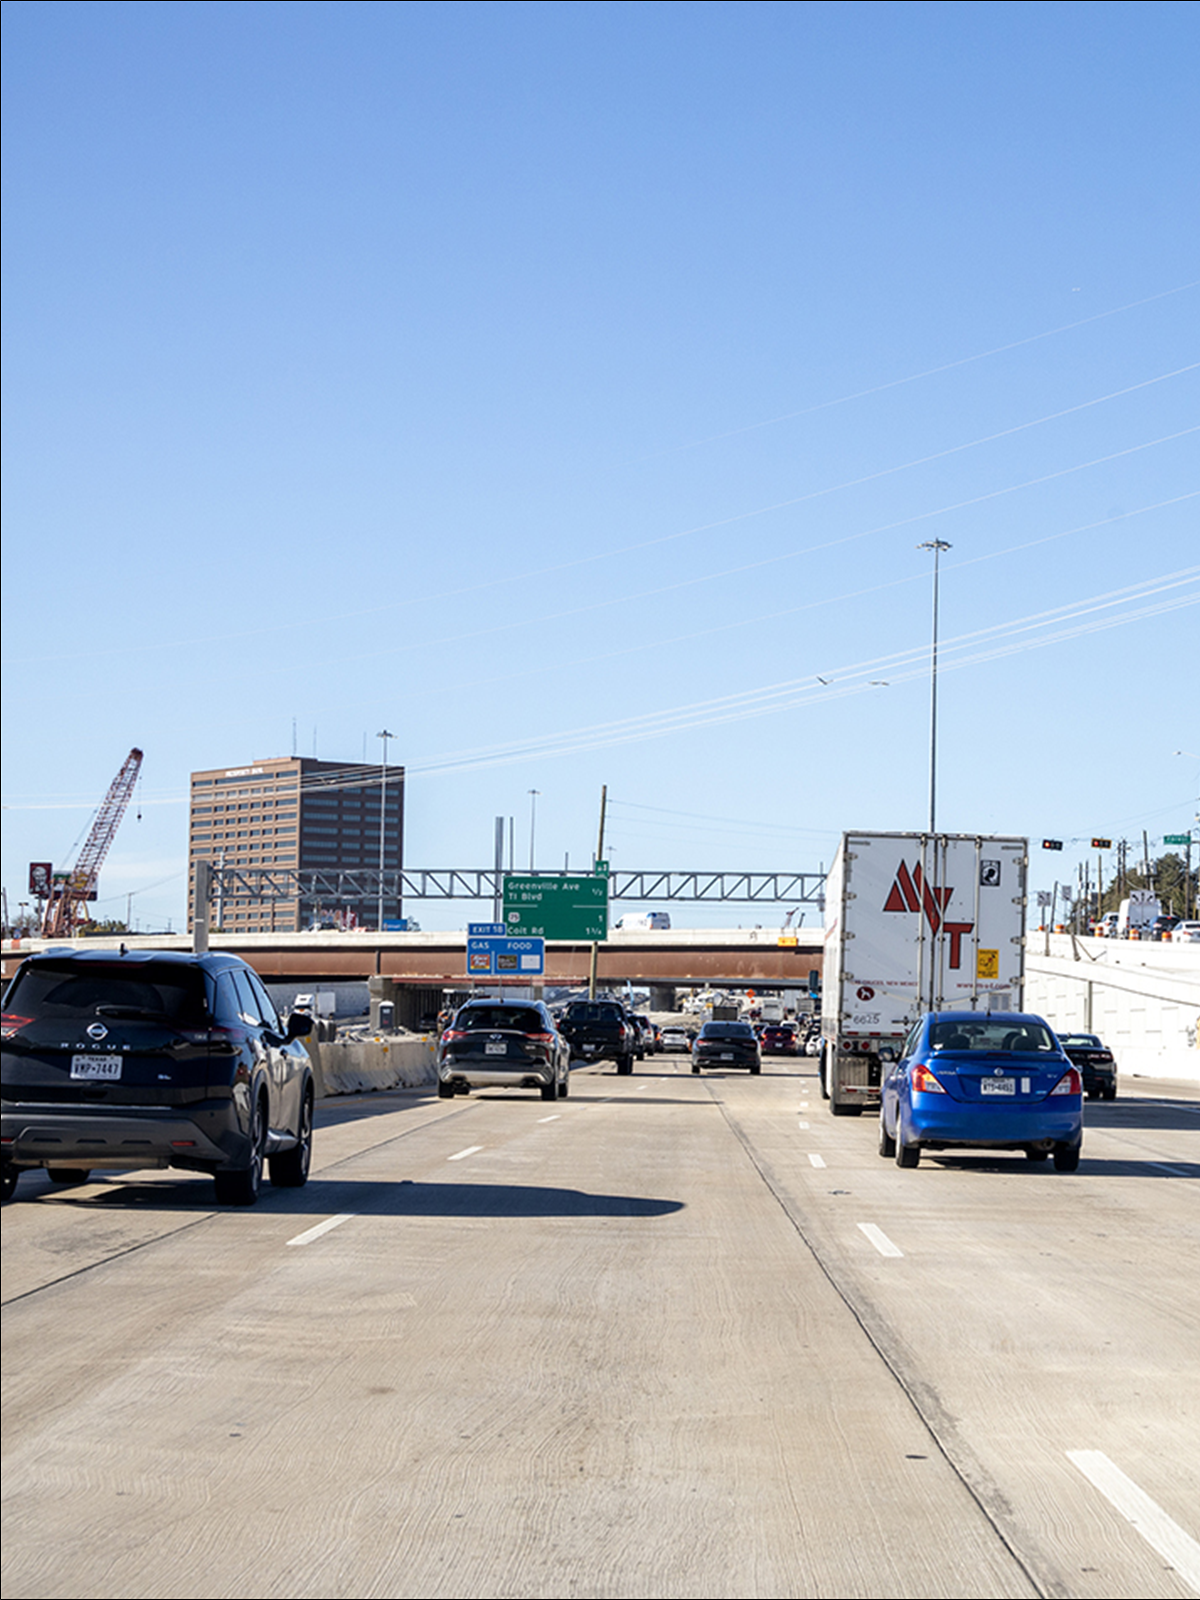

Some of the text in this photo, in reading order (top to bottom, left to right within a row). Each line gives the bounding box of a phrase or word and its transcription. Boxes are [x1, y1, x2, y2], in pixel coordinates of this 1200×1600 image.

[508, 882, 558, 890] Greenville
[531, 927, 544, 935] Rd
[471, 941, 532, 950] GAS FOOD
